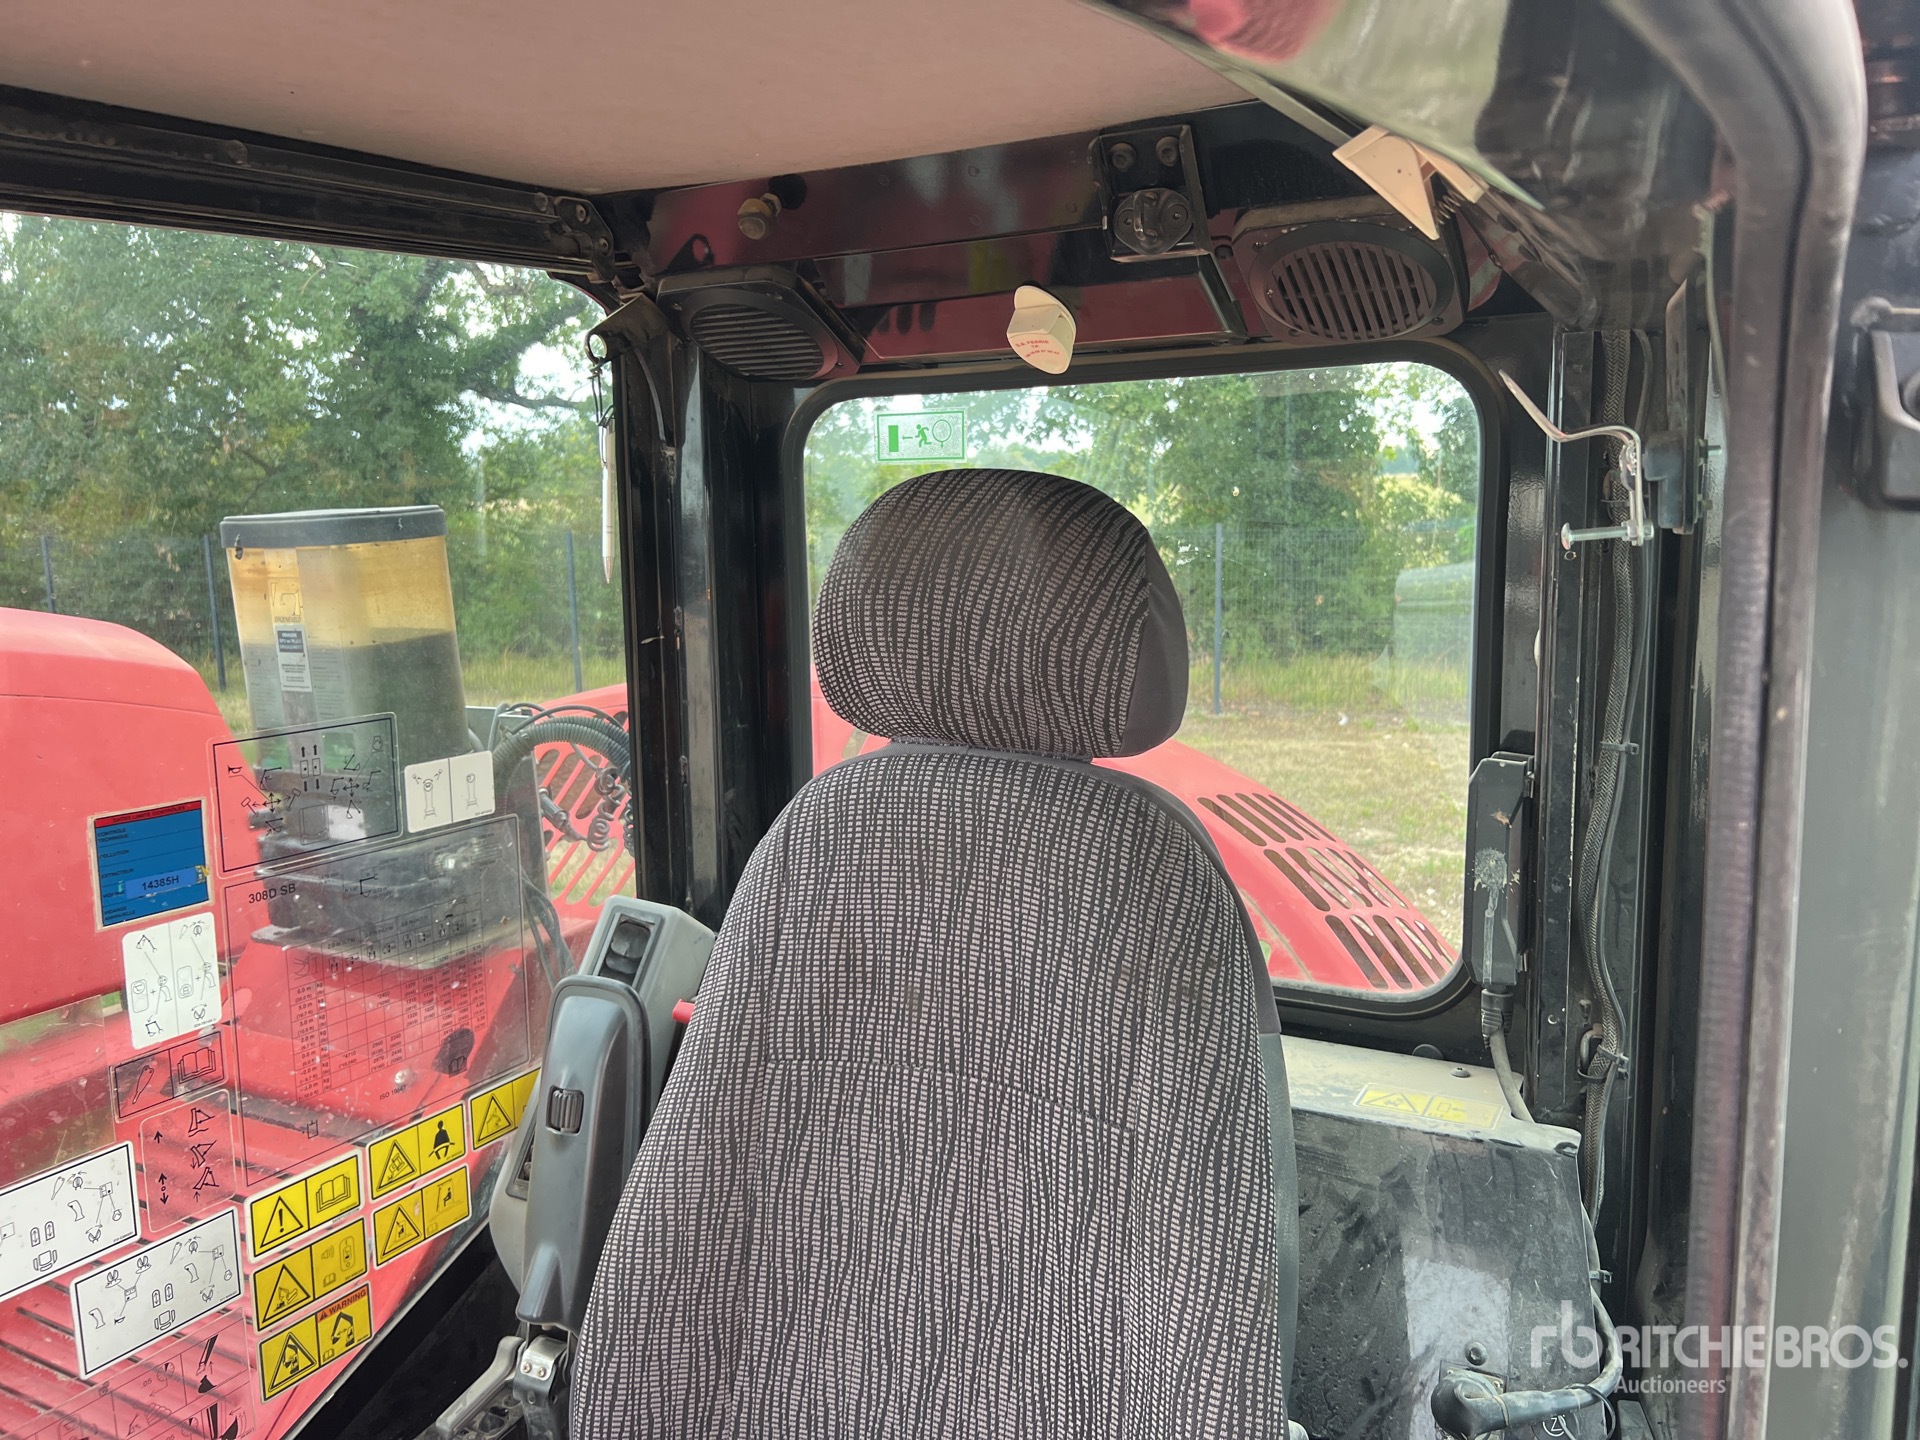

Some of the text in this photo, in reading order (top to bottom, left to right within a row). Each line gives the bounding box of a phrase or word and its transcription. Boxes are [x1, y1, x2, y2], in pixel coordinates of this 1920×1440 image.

[142, 875, 179, 891] 14385H
[248, 883, 296, 904] 308D SB
[379, 1091, 390, 1100] ISO
[329, 1289, 366, 1315] WARNING
